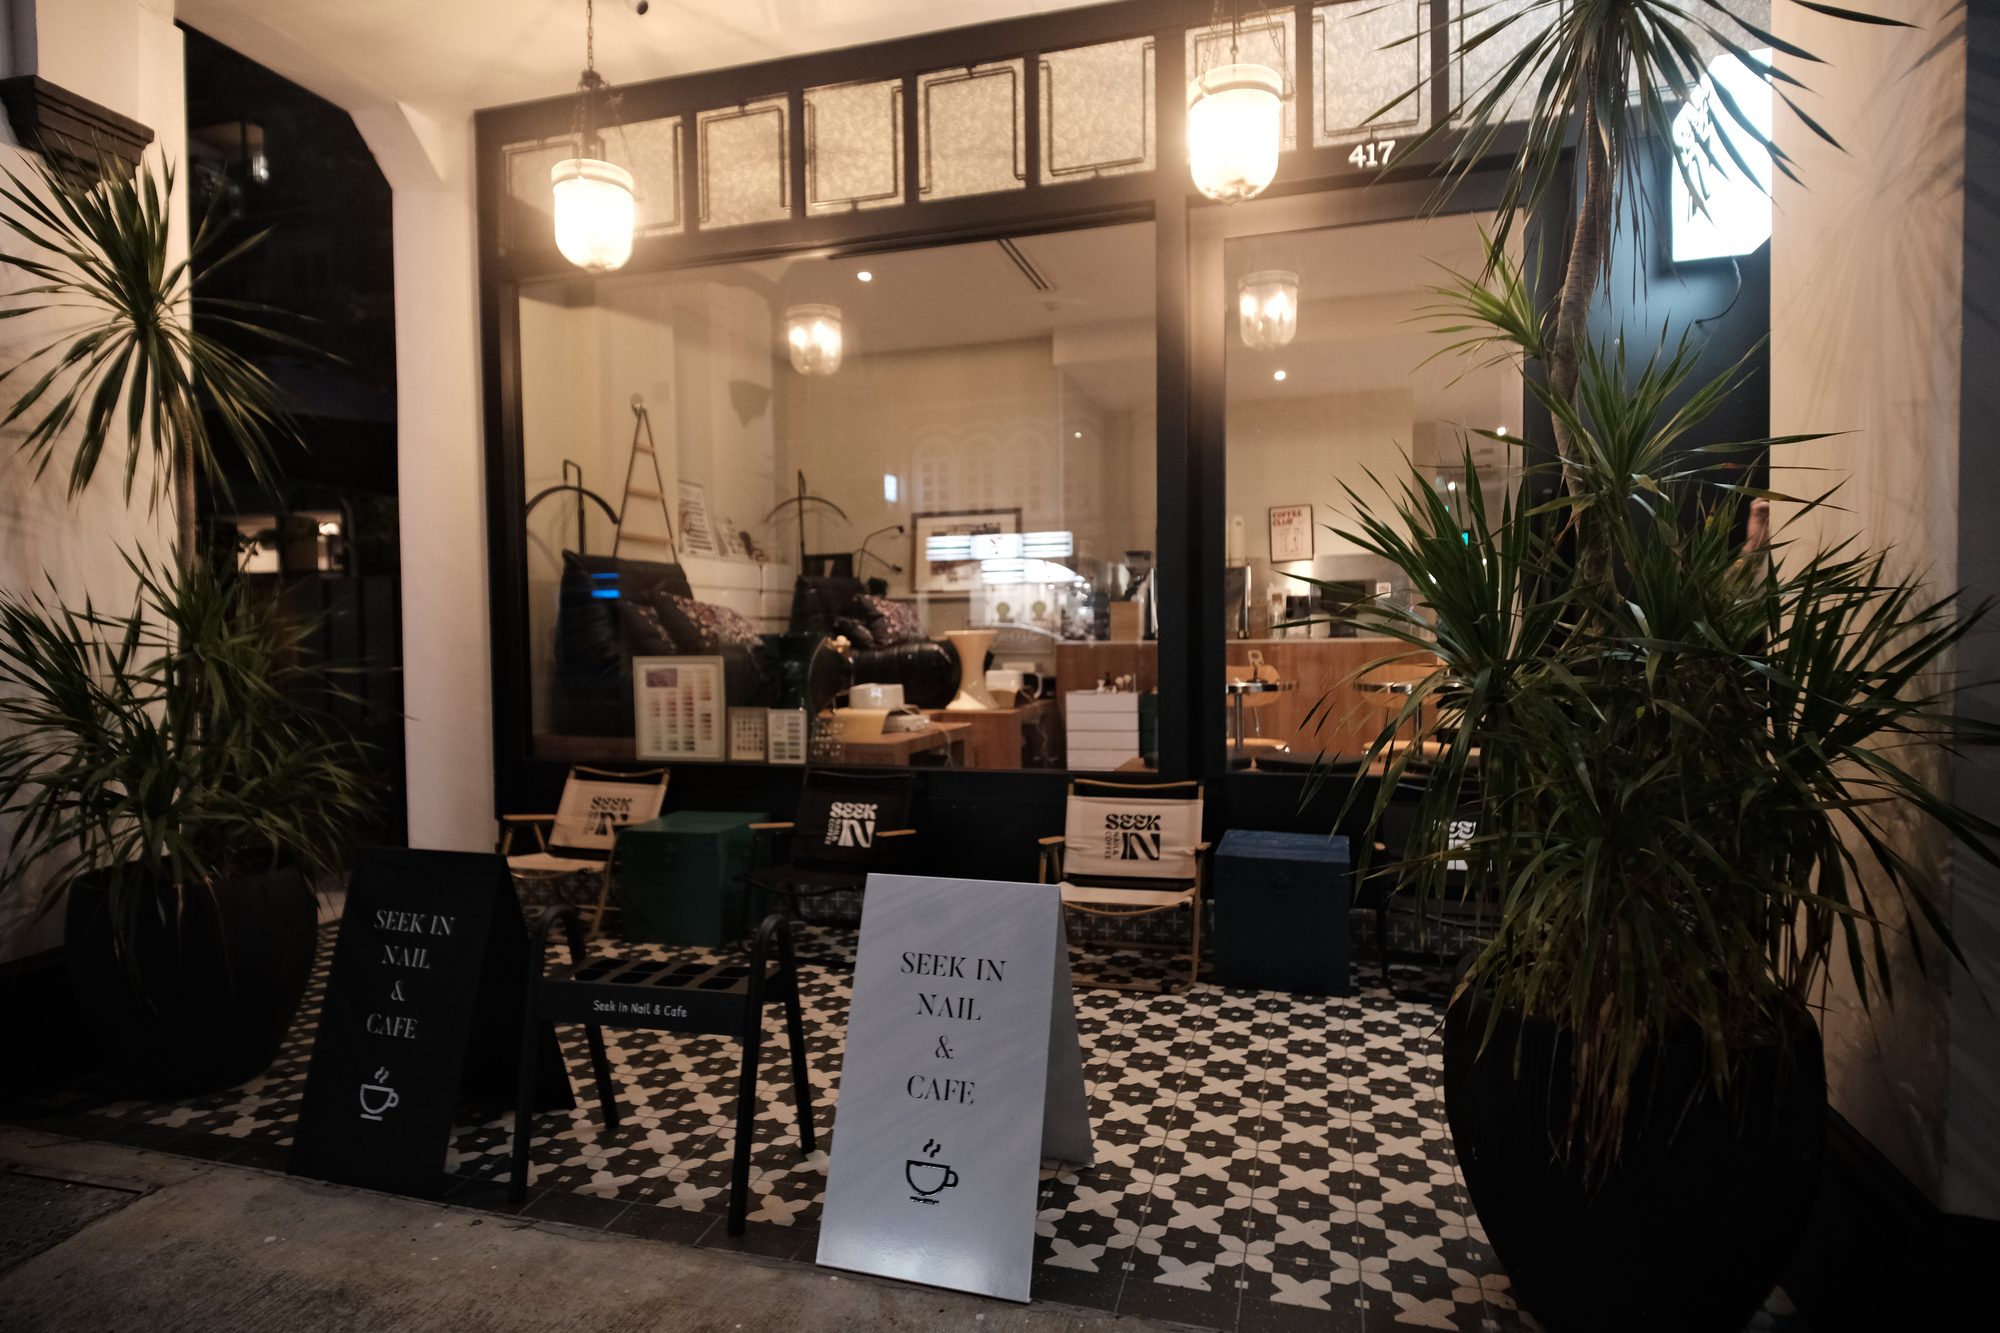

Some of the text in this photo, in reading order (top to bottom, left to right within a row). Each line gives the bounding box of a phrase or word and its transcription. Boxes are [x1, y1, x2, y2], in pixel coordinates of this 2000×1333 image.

[1348, 140, 1396, 168] 417
[591, 797, 633, 811] SEEK
[829, 801, 878, 820] SEEK
[837, 819, 876, 849] IN
[1105, 813, 1161, 831] SEEK
[1121, 832, 1161, 861] IN
[374, 909, 455, 936] SEEK IN
[381, 945, 430, 969] NAIL
[901, 951, 1007, 982] SEEK IN
[391, 980, 405, 1002] &
[593, 1000, 616, 1012] Seek
[630, 1003, 651, 1015] Nail
[653, 1004, 661, 1015] &
[663, 1005, 687, 1018] Cafe
[916, 993, 981, 1021] NAIL
[366, 1013, 418, 1039] CAFE
[935, 1034, 954, 1059] &
[907, 1074, 975, 1105] CAFE
